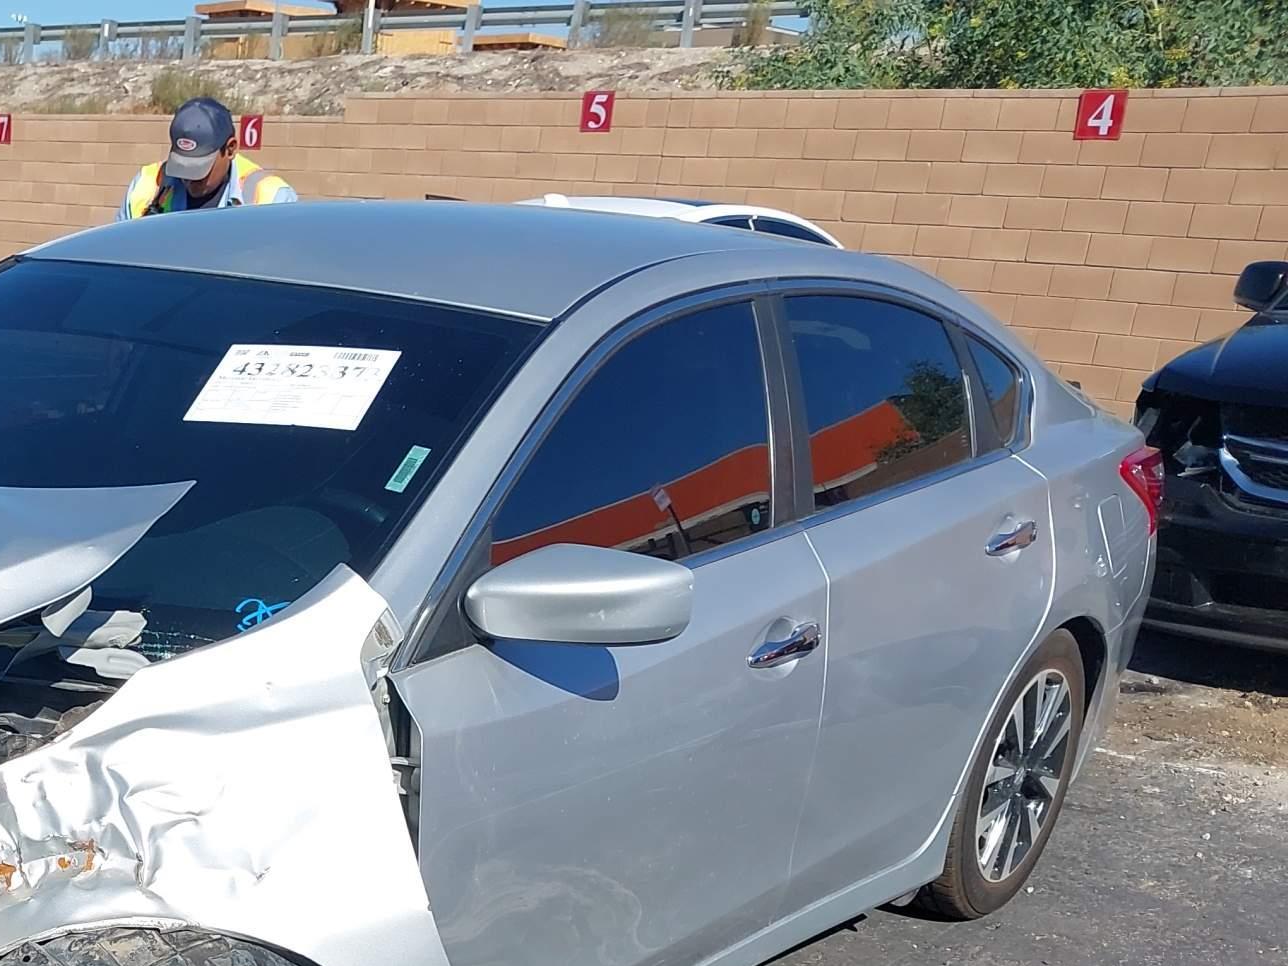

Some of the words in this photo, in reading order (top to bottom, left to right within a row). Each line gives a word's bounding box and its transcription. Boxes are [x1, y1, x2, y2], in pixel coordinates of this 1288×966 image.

[588, 94, 609, 129] 5
[1087, 93, 1116, 136] 4
[244, 118, 258, 146] 6
